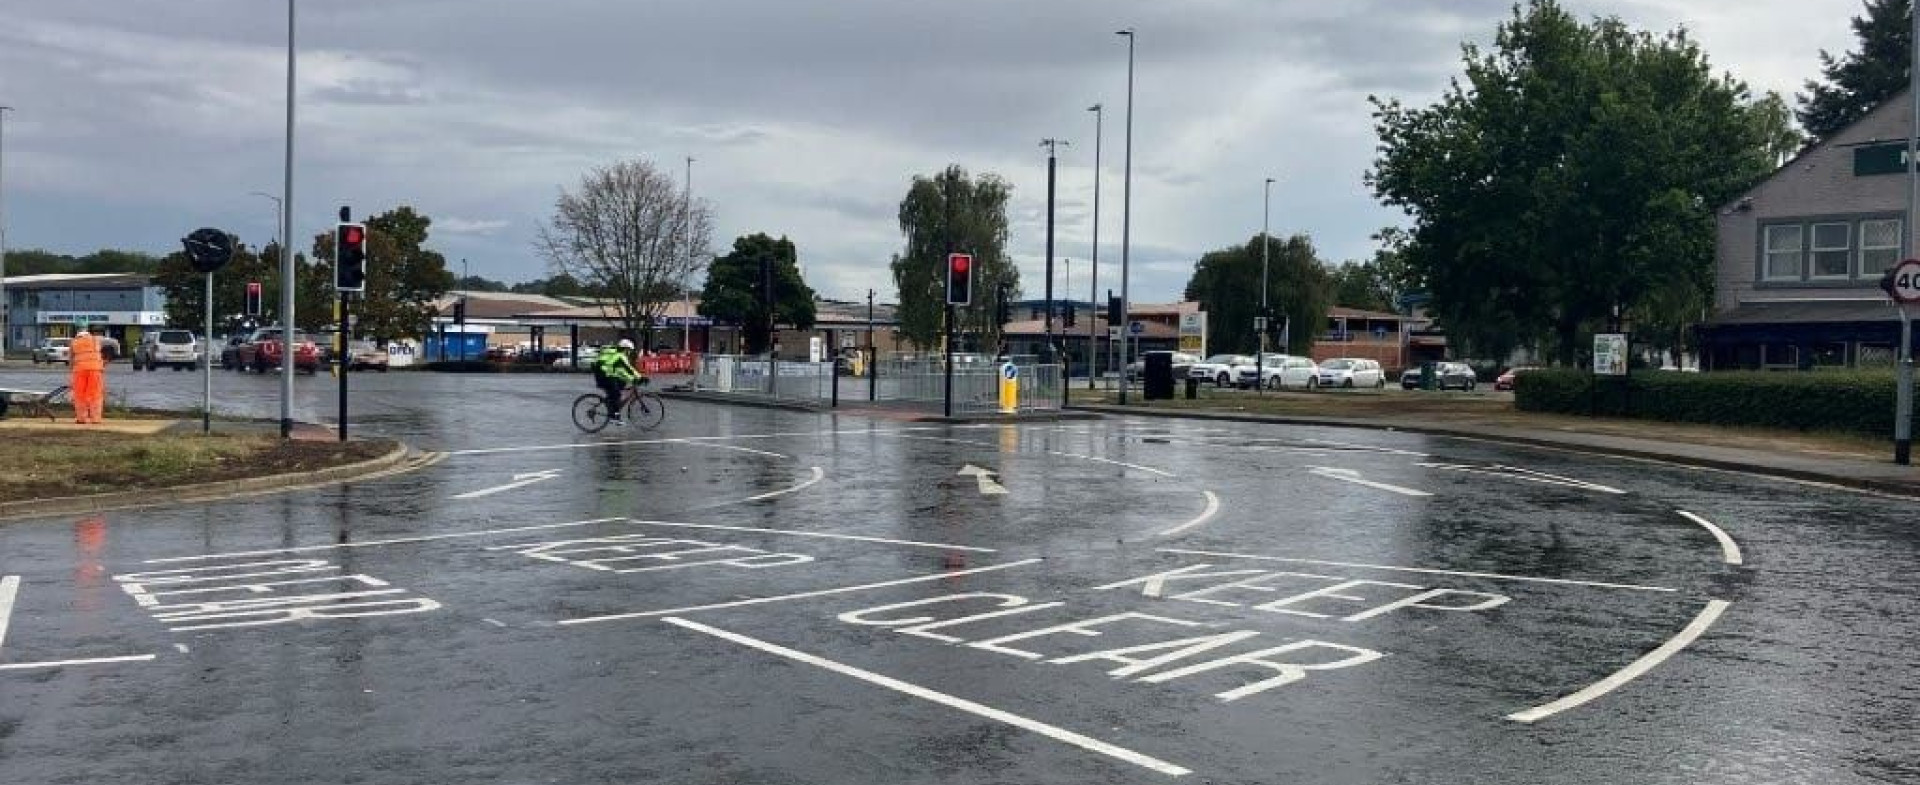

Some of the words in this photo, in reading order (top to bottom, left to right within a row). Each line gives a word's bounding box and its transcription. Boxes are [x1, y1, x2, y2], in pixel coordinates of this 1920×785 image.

[1897, 272, 1920, 290] 40
[483, 533, 815, 573] KEEP
[1094, 563, 1511, 622] KEEP
[838, 592, 1384, 701] CLEAR
